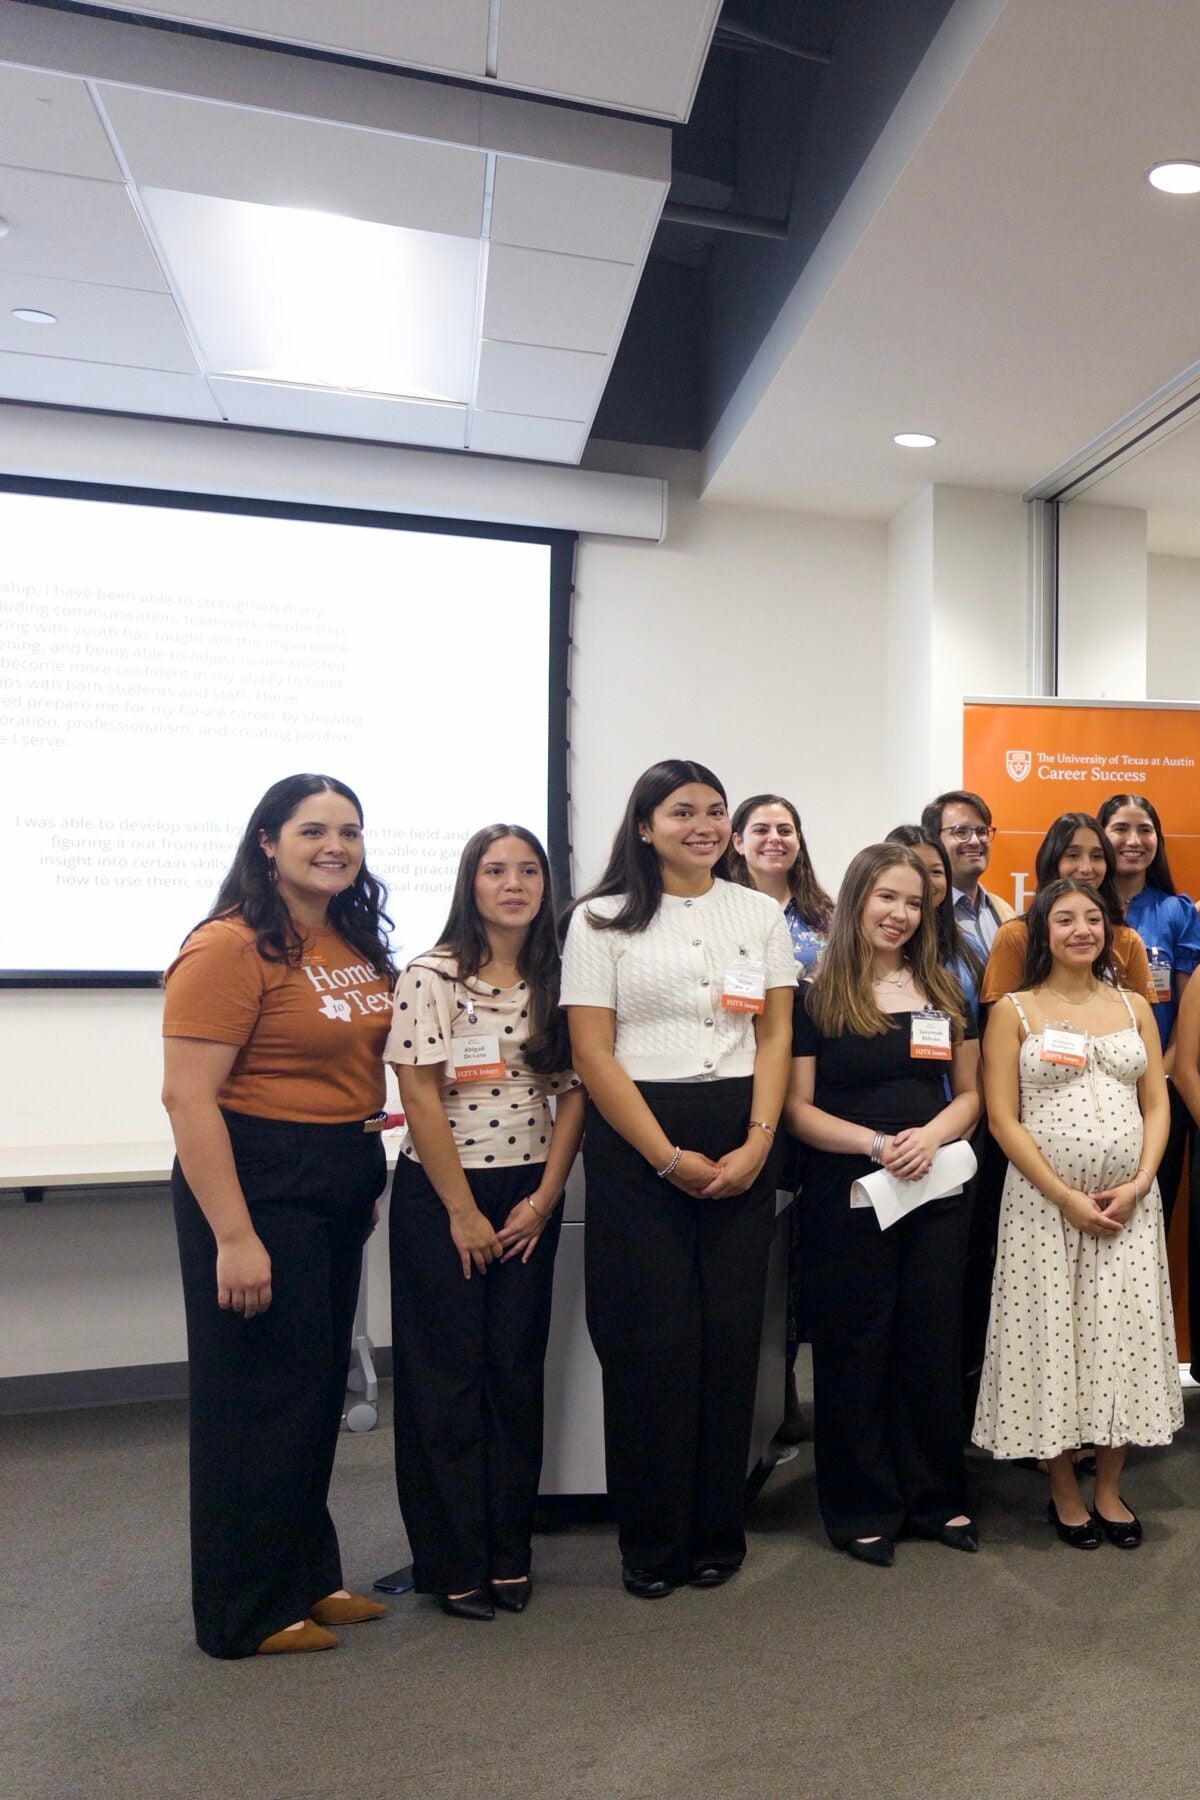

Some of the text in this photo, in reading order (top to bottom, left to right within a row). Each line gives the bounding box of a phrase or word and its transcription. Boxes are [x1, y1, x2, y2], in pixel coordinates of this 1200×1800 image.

[55, 584, 92, 599] have
[97, 588, 136, 602] been
[141, 591, 173, 605] able
[178, 595, 192, 607] to
[198, 598, 280, 614] strengthen
[283, 604, 323, 619] many
[54, 604, 179, 625] communication,
[34, 622, 349, 655] with youth has taught me the importance
[50, 642, 80, 655] and
[86, 644, 129, 661] being
[132, 646, 165, 660] able
[170, 650, 186, 662] to
[190, 651, 236, 666] adjust
[241, 655, 256, 666] to
[260, 657, 346, 672] unexpected
[1, 657, 343, 690] become more confident in my ability to build
[27, 676, 61, 690] with
[66, 679, 103, 692] both
[108, 682, 176, 698] students
[179, 688, 208, 699] and
[256, 690, 297, 704] These
[27, 698, 363, 729] prepare me for my future career by showing
[21, 735, 70, 749] serve.
[66, 718, 193, 735] professionalism,
[199, 725, 227, 737] and
[232, 727, 291, 743] creating
[296, 730, 352, 744] positive
[1037, 752, 1194, 767] The University of Texas at Austin
[1038, 766, 1146, 782] Career Success
[16, 816, 20, 827] I
[25, 818, 56, 829] was
[60, 817, 94, 830] able
[99, 819, 114, 830] to
[120, 817, 181, 834] develop
[185, 820, 221, 834] skills
[382, 826, 405, 838] the
[410, 828, 439, 841] field
[443, 830, 469, 841] and
[51, 834, 112, 851] figuring
[117, 836, 126, 849] it
[131, 838, 157, 850] out
[161, 837, 198, 851] from
[388, 845, 418, 858] able
[422, 847, 437, 858] to
[40, 854, 92, 870] insight
[98, 856, 128, 869] into
[132, 856, 186, 870] certain
[383, 863, 409, 874] and
[56, 873, 89, 887] how
[94, 875, 110, 887] to
[115, 877, 142, 888] use
[196, 878, 213, 889] so
[301, 962, 380, 992] Home
[333, 1004, 344, 1013] to
